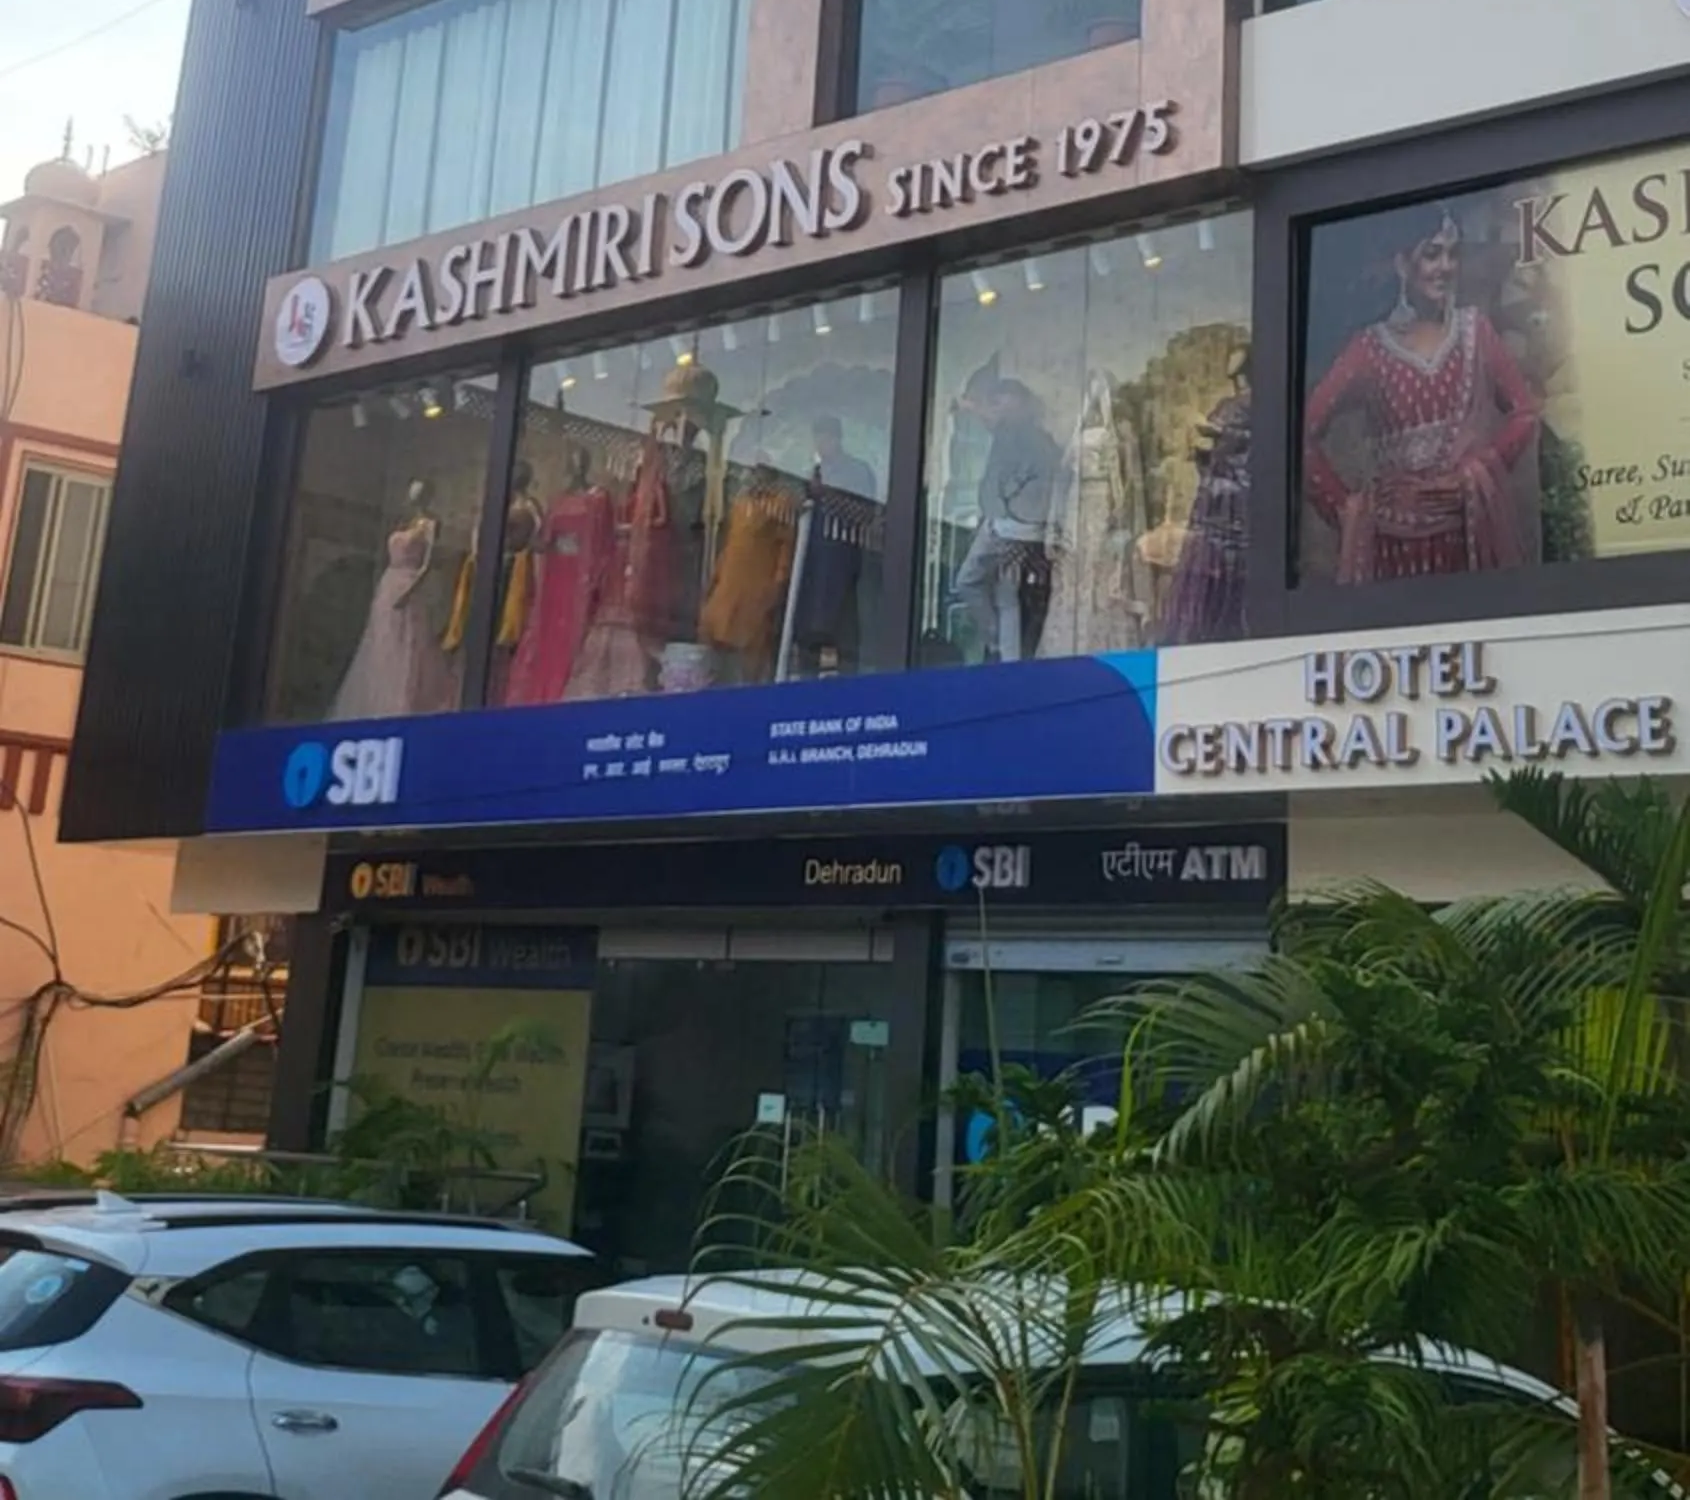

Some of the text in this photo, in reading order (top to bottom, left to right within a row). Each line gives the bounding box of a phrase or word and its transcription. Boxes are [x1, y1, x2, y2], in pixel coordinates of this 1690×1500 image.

[339, 191, 656, 347] KASHMIRI
[671, 138, 870, 268] SONS
[885, 134, 1038, 217] SINCE
[1054, 99, 1177, 174] 1975
[1574, 465, 1642, 492] Saree,
[1303, 640, 1497, 704] HOTEL
[808, 718, 843, 735] BANK
[845, 716, 863, 732] OF
[1159, 695, 1678, 776] CENTRAL PALACE
[326, 736, 404, 805] SBI
[374, 863, 418, 897] SBI
[805, 859, 902, 886] Dehradun
[972, 845, 1031, 888] SBI
[1101, 841, 1177, 882] एटीएम
[1180, 845, 1267, 881] ATM
